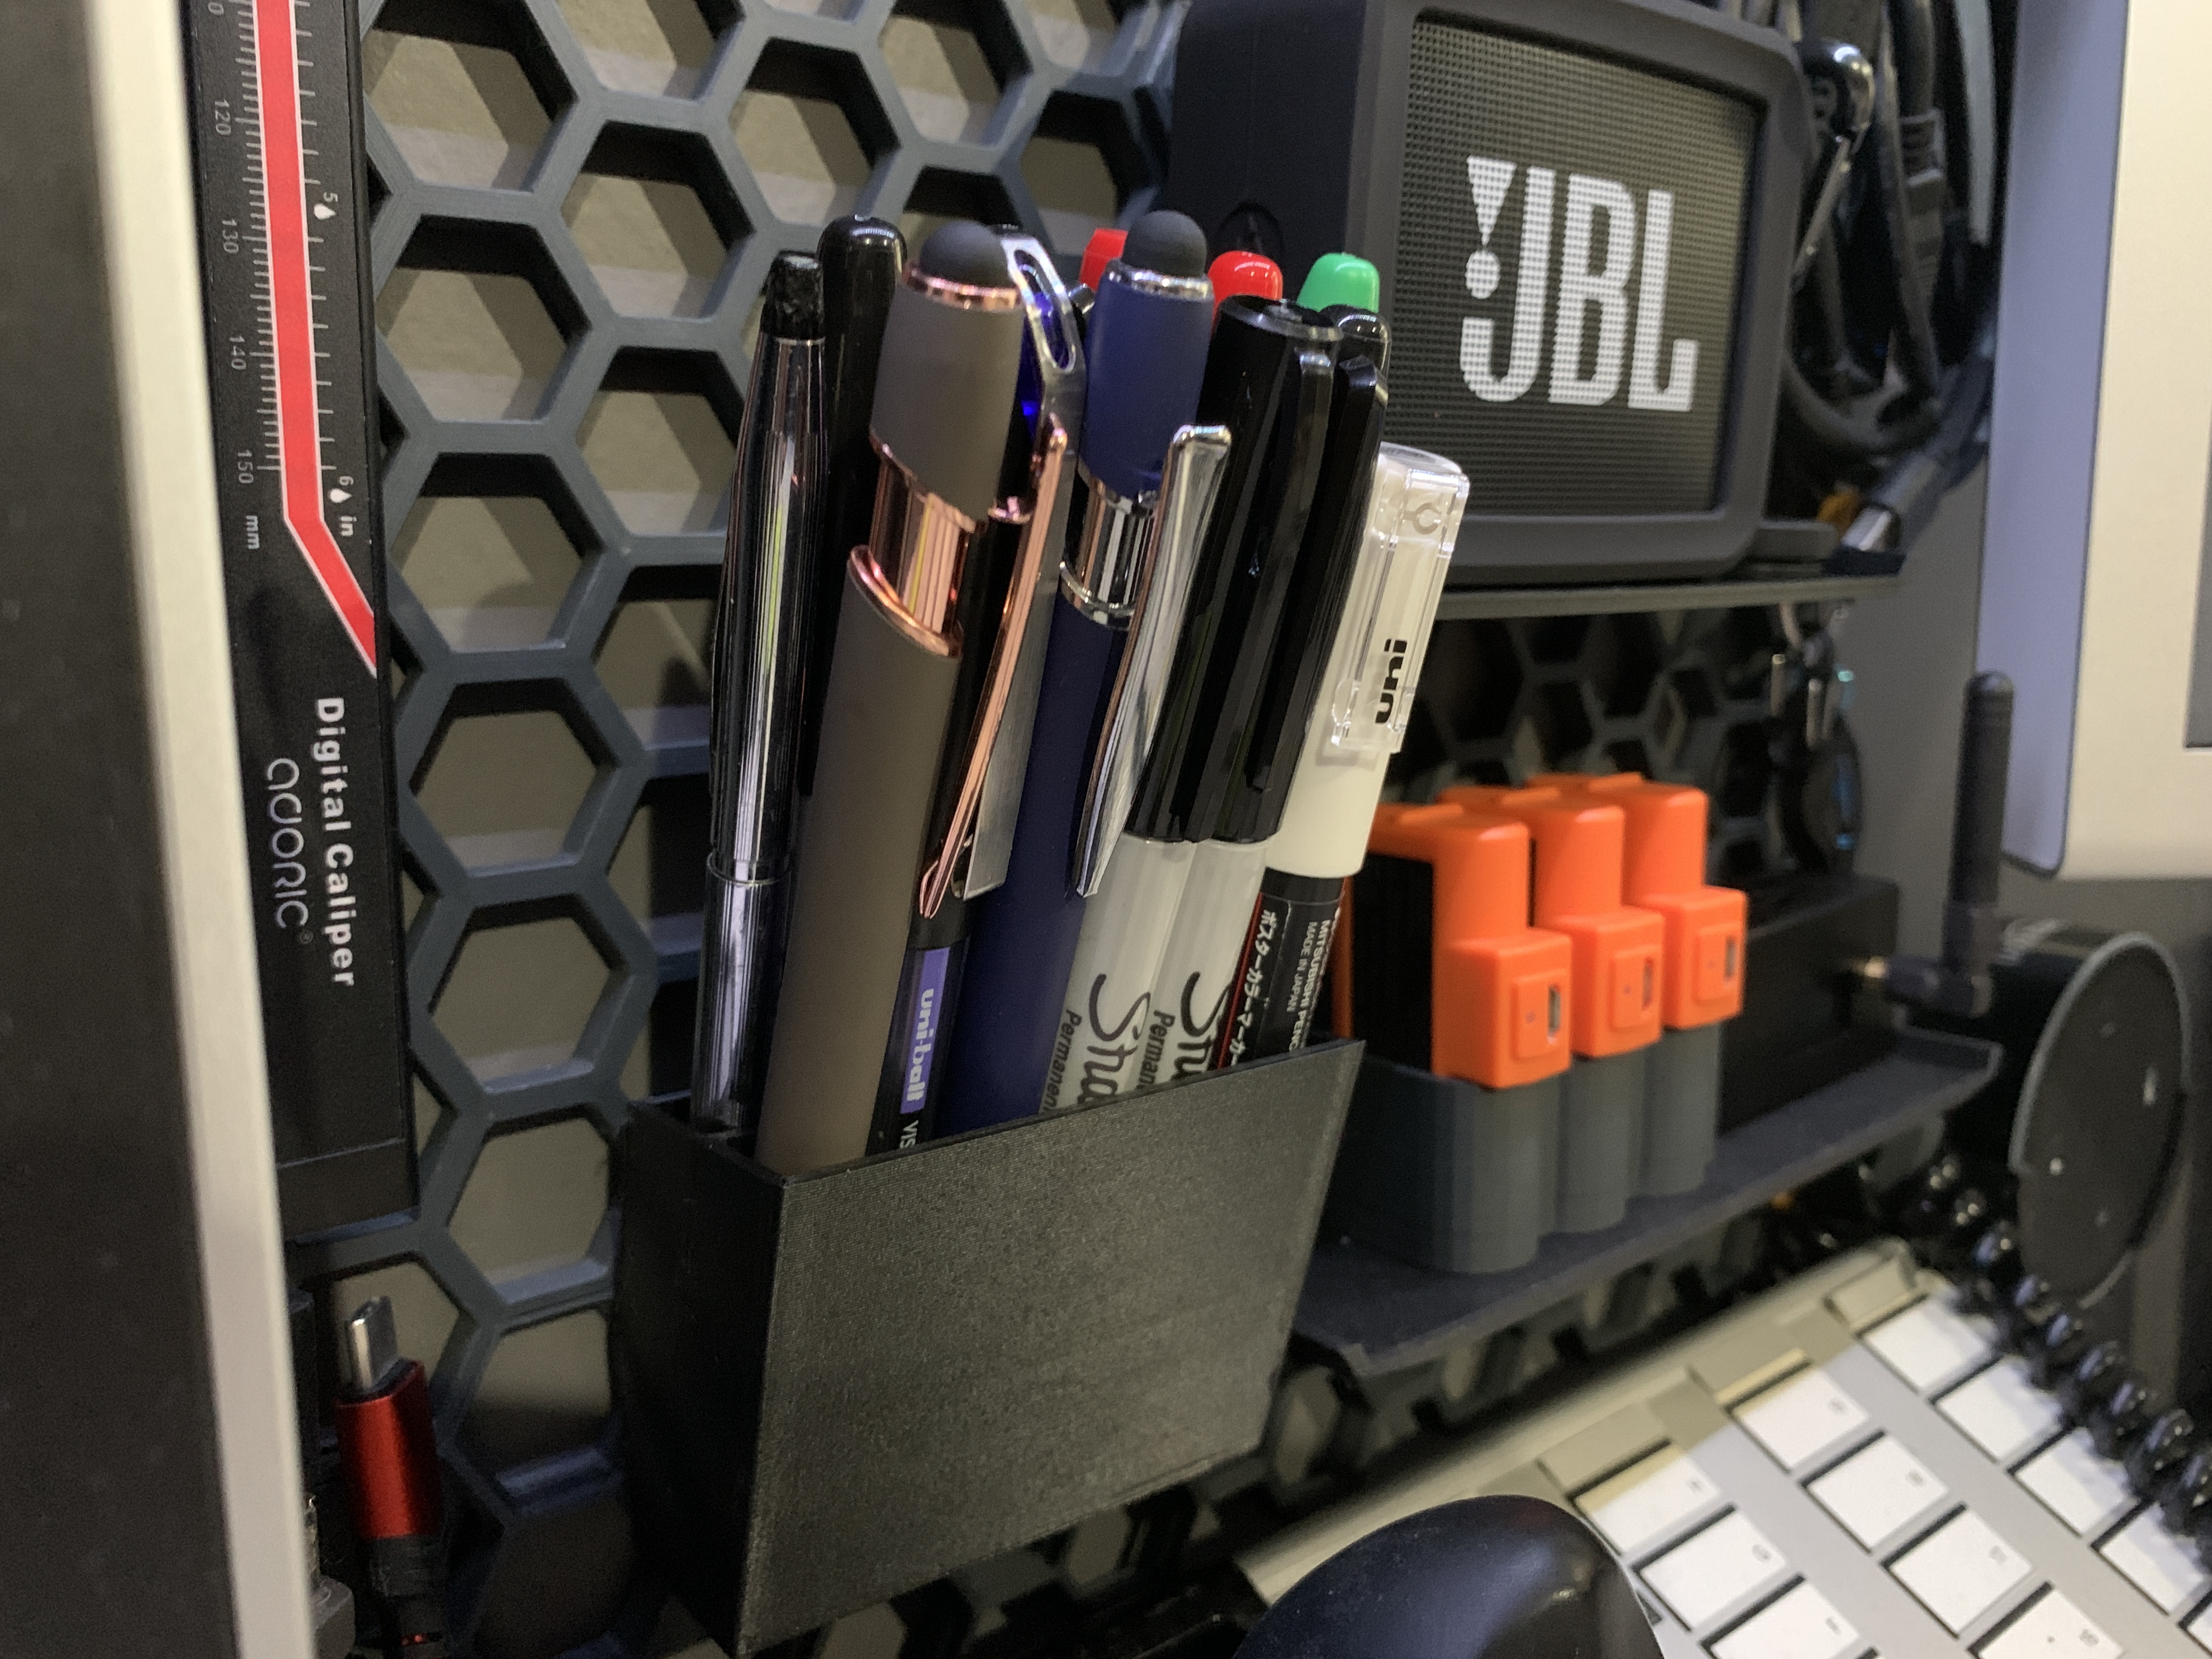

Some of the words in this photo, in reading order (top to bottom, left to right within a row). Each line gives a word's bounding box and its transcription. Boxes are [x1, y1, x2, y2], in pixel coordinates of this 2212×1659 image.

[214, 99, 232, 136] 120
[323, 191, 338, 202] 5
[222, 218, 239, 254] 130
[1460, 155, 1700, 411] JBL
[229, 335, 247, 371] 140
[237, 449, 255, 484] 150
[338, 475, 354, 486] 6
[245, 515, 261, 550] mm
[340, 515, 357, 537] in
[1375, 637, 1408, 724] uni
[311, 697, 352, 831] Digital
[321, 843, 357, 986] Caliper
[1301, 921, 1318, 956] MADE
[1296, 958, 1307, 972] IN
[1300, 919, 1332, 1007] MITSUBISHI
[1286, 973, 1304, 1012] JAPAN
[906, 988, 934, 1101] uni-ball
[1077, 973, 1151, 1104] Sha
[1136, 1009, 1176, 1089] Perman
[1289, 1009, 1308, 1052] PENC
[899, 1120, 919, 1149] VIS
